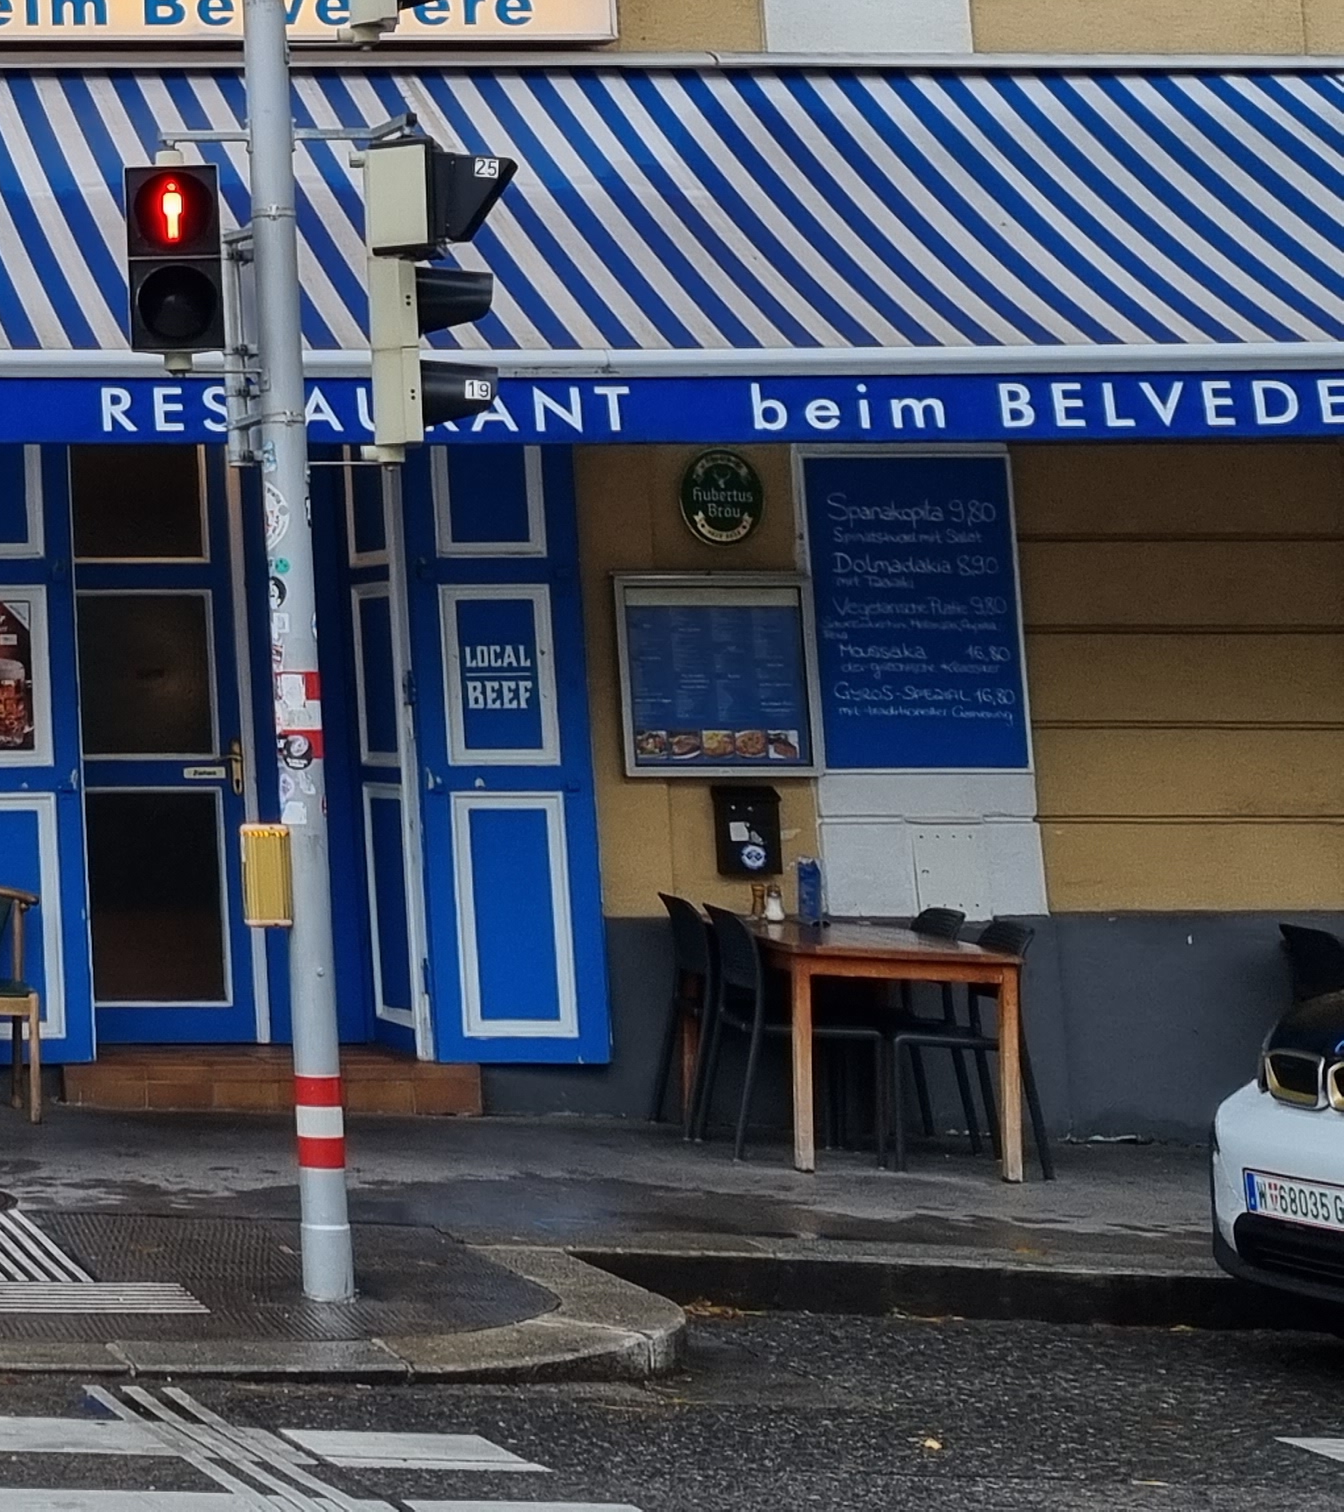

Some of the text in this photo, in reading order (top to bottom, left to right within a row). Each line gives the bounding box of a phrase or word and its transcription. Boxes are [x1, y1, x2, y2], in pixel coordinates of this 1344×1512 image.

[476, 159, 497, 176] 25
[468, 381, 489, 398] 19
[100, 384, 631, 433] RESAANT
[749, 383, 946, 430] beim
[998, 378, 1344, 428] BELVEDE
[693, 487, 753, 502] Hubertus
[948, 499, 996, 527] 9,80
[465, 645, 531, 668] LOCAL
[466, 680, 532, 709] BEEF
